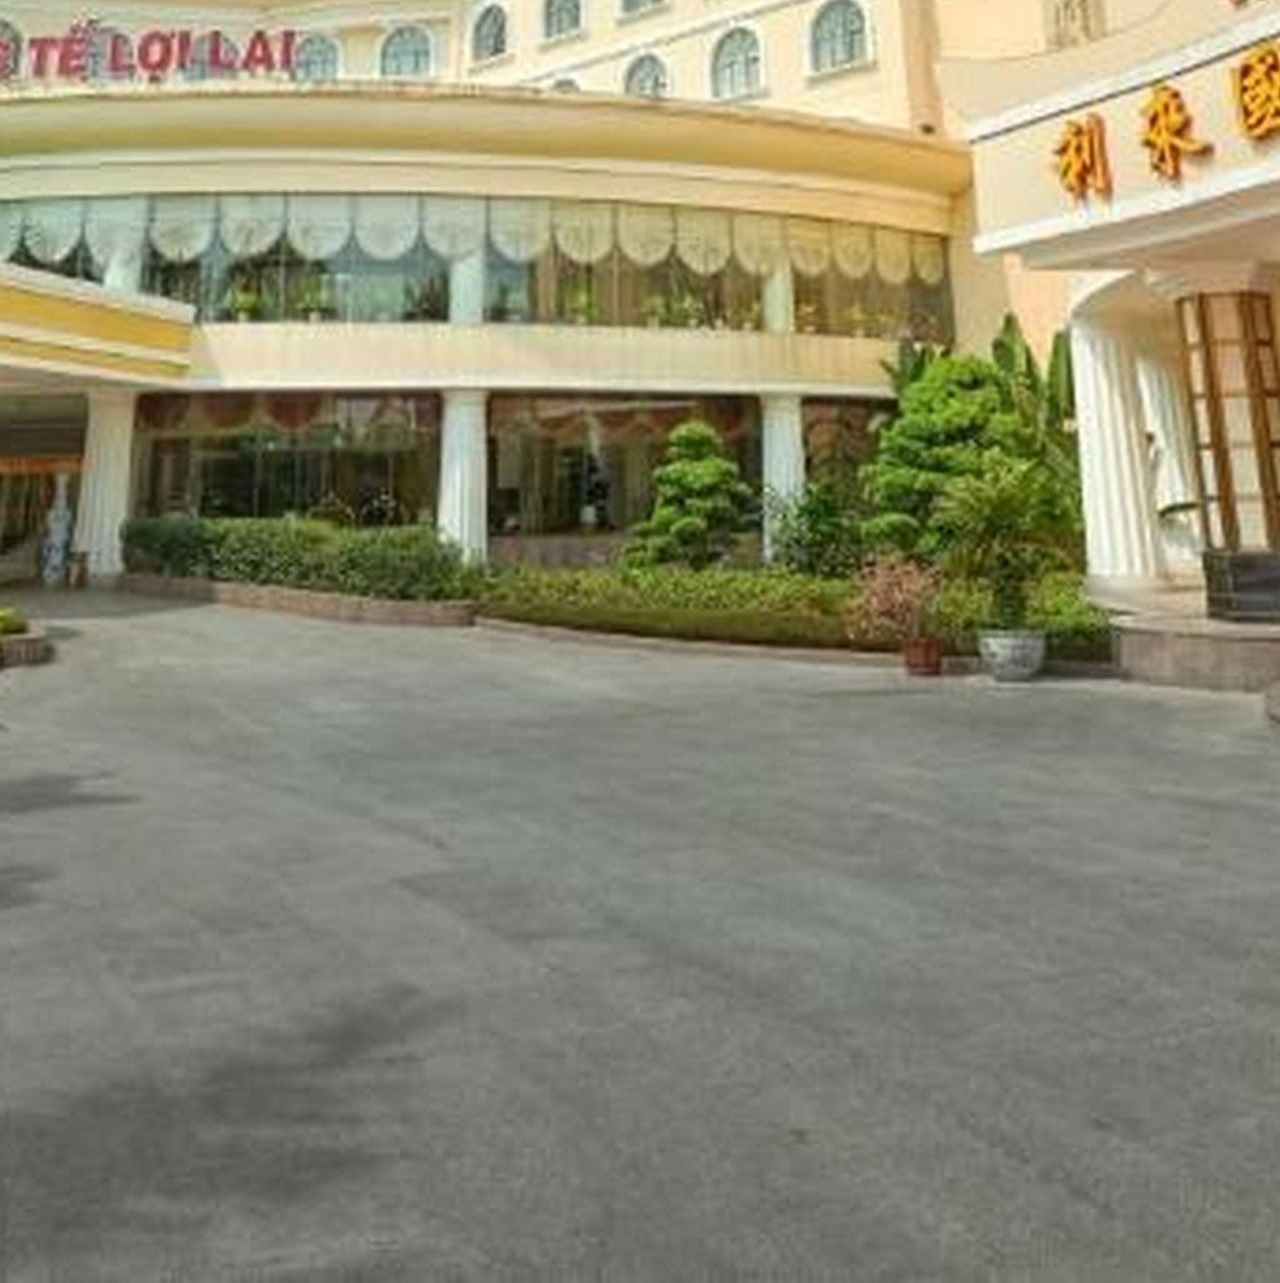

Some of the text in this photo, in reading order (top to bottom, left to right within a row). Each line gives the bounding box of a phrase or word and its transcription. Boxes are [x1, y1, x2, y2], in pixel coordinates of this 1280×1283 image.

[28, 17, 91, 81] TẾ
[107, 29, 192, 82] LỢI
[208, 29, 296, 78] LAI
